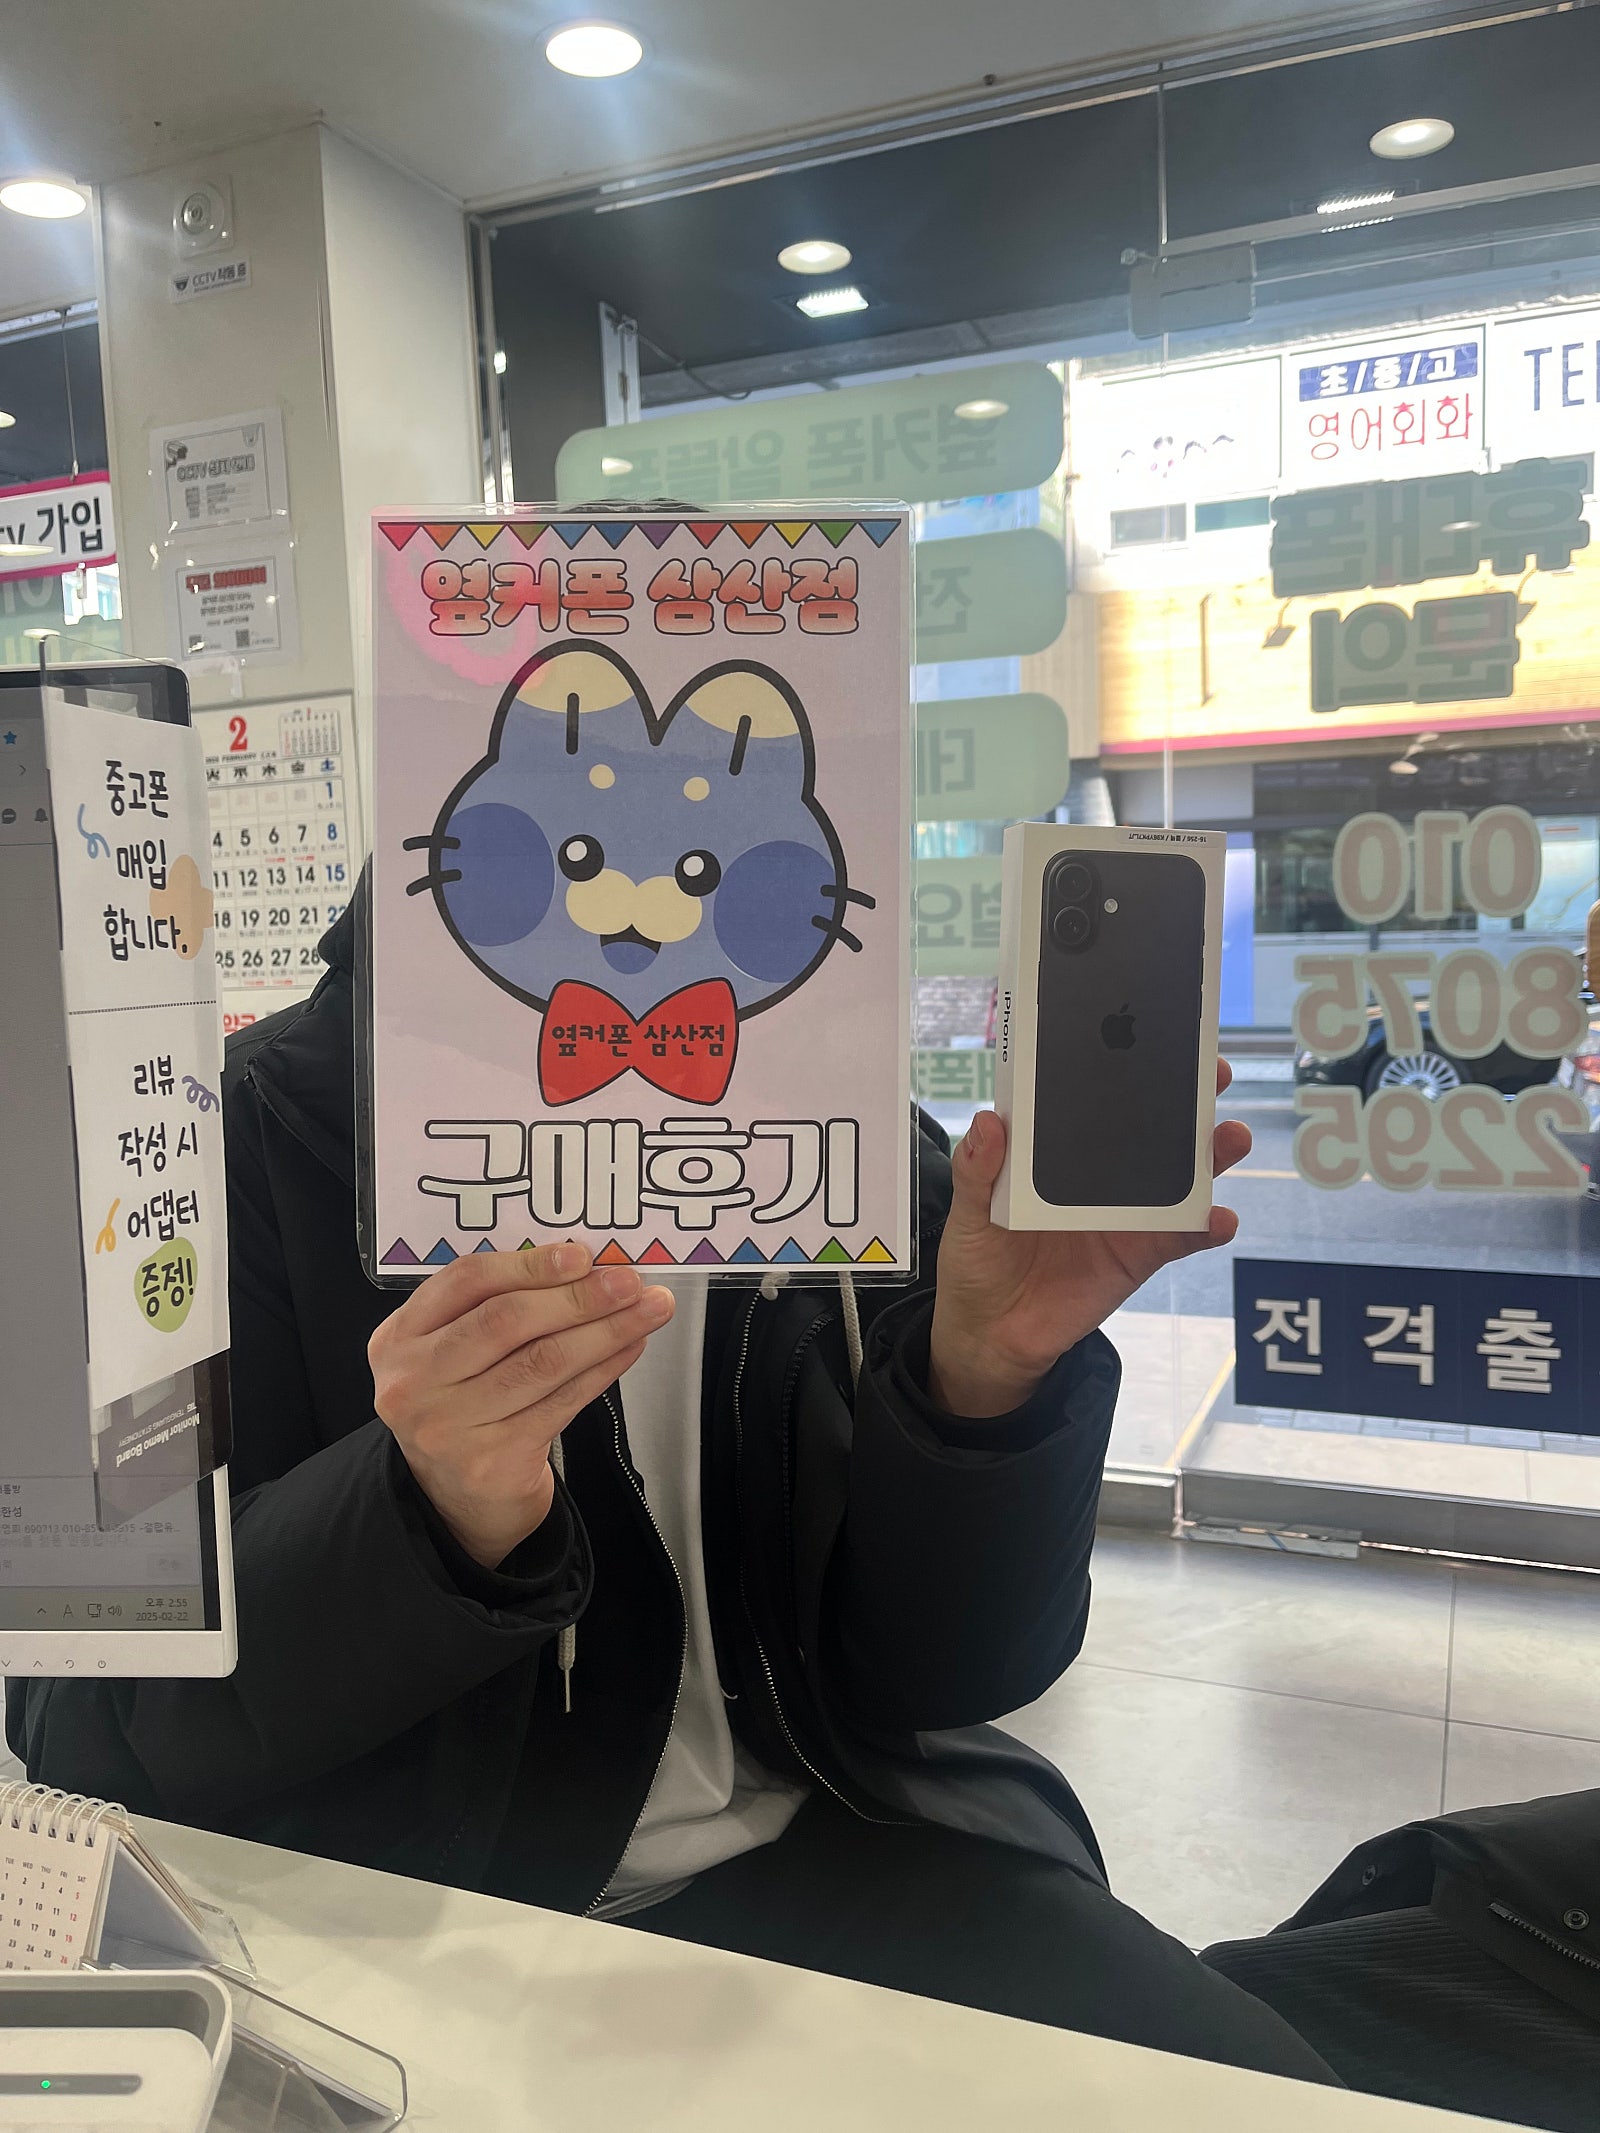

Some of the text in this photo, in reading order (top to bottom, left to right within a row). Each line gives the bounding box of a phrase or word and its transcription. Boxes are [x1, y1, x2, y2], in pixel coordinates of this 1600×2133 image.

[1308, 392, 1474, 460] 영어회화
[37, 497, 103, 555] 가입
[420, 556, 860, 636] 옆커폰 삼산점
[228, 715, 249, 753] 2
[262, 763, 277, 777] 木
[321, 758, 335, 772] 土
[105, 759, 170, 819] 중고폰
[325, 781, 333, 800] 1
[212, 822, 337, 848] 4 5 6 7 8
[116, 839, 167, 891] 매입
[213, 864, 346, 889] 11 12 13 14 15
[103, 904, 188, 962] 합니다.
[214, 910, 232, 930] 18
[240, 909, 260, 928] 19
[268, 908, 291, 926] 20
[299, 906, 319, 925] 21
[214, 947, 320, 969] 25 26 27 28
[551, 1023, 726, 1058] 옆커폰 삼산점
[1002, 990, 1012, 1063] iPhone
[133, 1055, 175, 1096] 리뷰
[118, 1121, 198, 1178] 작성 시
[418, 1116, 859, 1231] 구매후기
[127, 1189, 200, 1242] 어댑터
[142, 1256, 194, 1318] 증정!
[1252, 1297, 1562, 1395] 전 격 출
[116, 1412, 200, 1468] Monitor Memo Board
[135, 1612, 189, 1622] 2025-02-22
[145, 1598, 188, 1608] 오후 2:55
[5, 1857, 86, 1883] TUE WED THU FRI SAT
[22, 1877, 27, 1885] 2
[40, 1881, 45, 1890] 3
[58, 1886, 63, 1894] 4
[75, 1891, 80, 1900] 5
[18, 1897, 23, 1906] 9
[35, 1902, 43, 1911] 10
[53, 1907, 60, 1916] 11
[70, 1912, 77, 1922] 12
[9, 1938, 17, 1948] 23
[26, 1943, 35, 1953] 24
[44, 1949, 52, 1959] 25
[14, 1918, 73, 1943] 16 17 18 19
